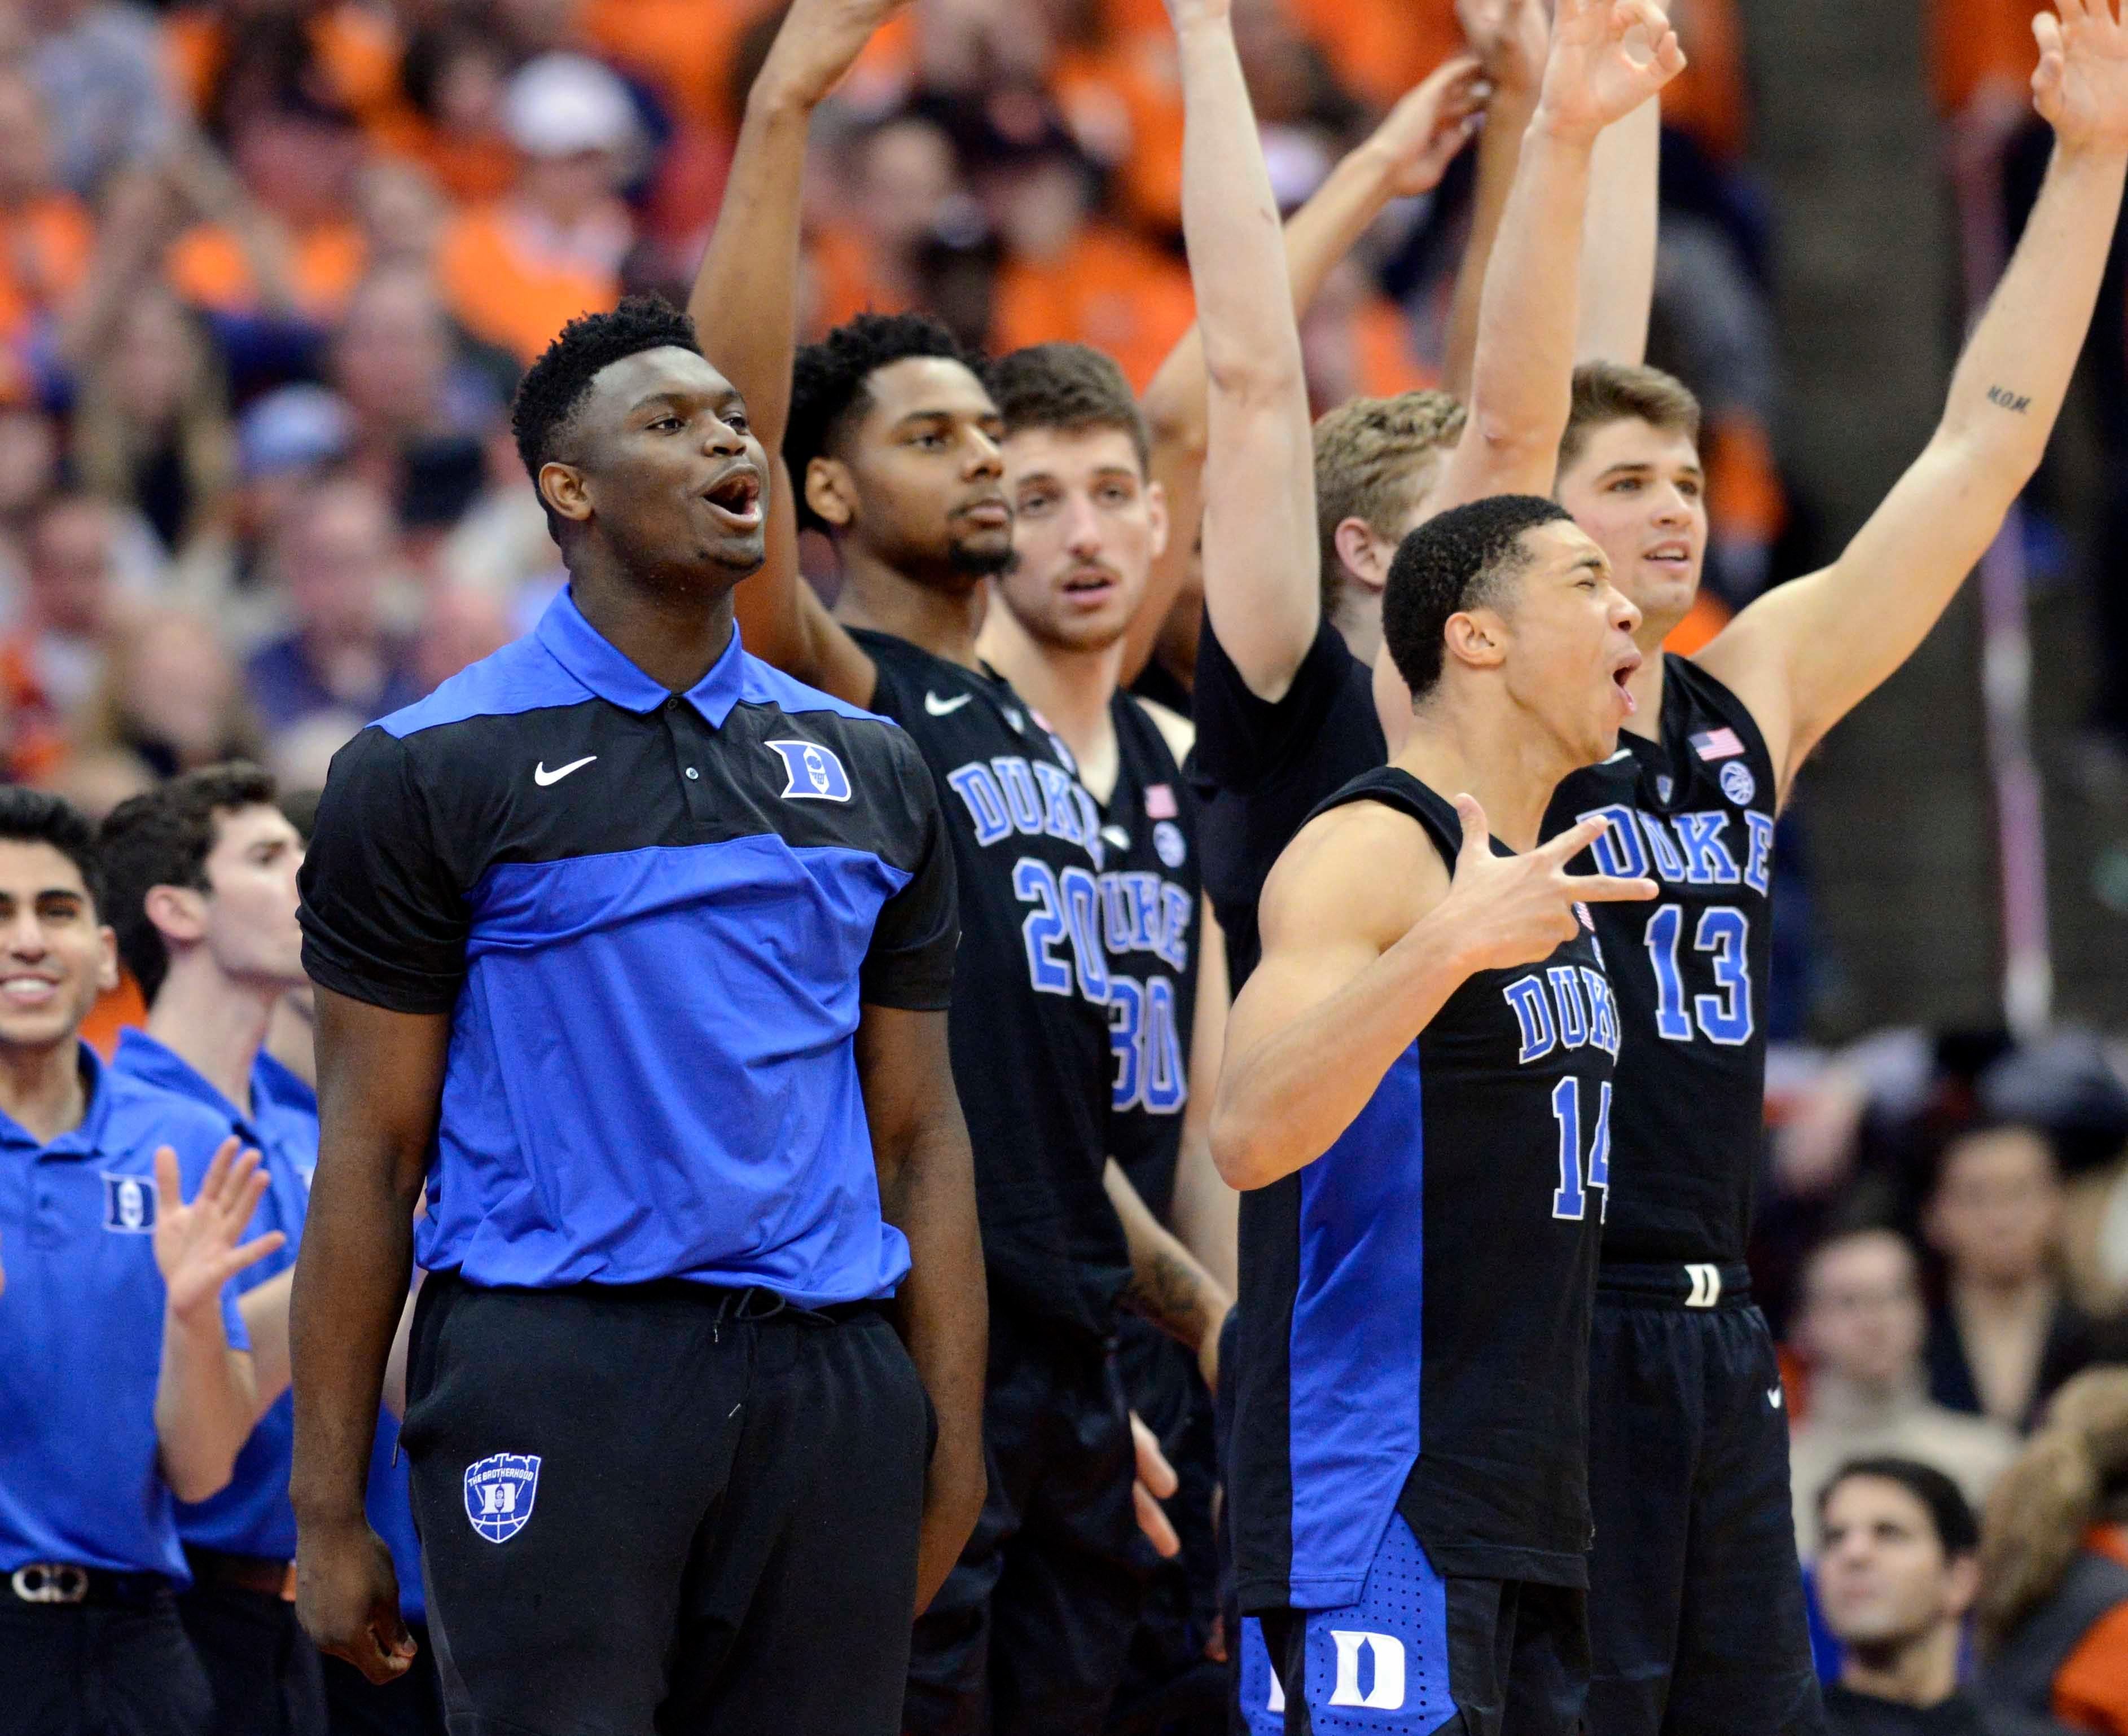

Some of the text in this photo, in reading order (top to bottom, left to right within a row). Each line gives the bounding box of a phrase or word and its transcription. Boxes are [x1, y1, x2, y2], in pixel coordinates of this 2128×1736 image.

[764, 740, 852, 802] D
[1576, 803, 1775, 897] DUKE
[1013, 856, 1110, 1004] 20
[1098, 871, 1193, 974] UKE
[1503, 965, 1622, 1067] DUK
[1643, 904, 1754, 1046] 13
[1108, 974, 1188, 1115] 30
[1684, 1263, 1721, 1307] D
[467, 1467, 534, 1487] THE BROTHERHOOD
[1328, 1630, 1405, 1711] D
